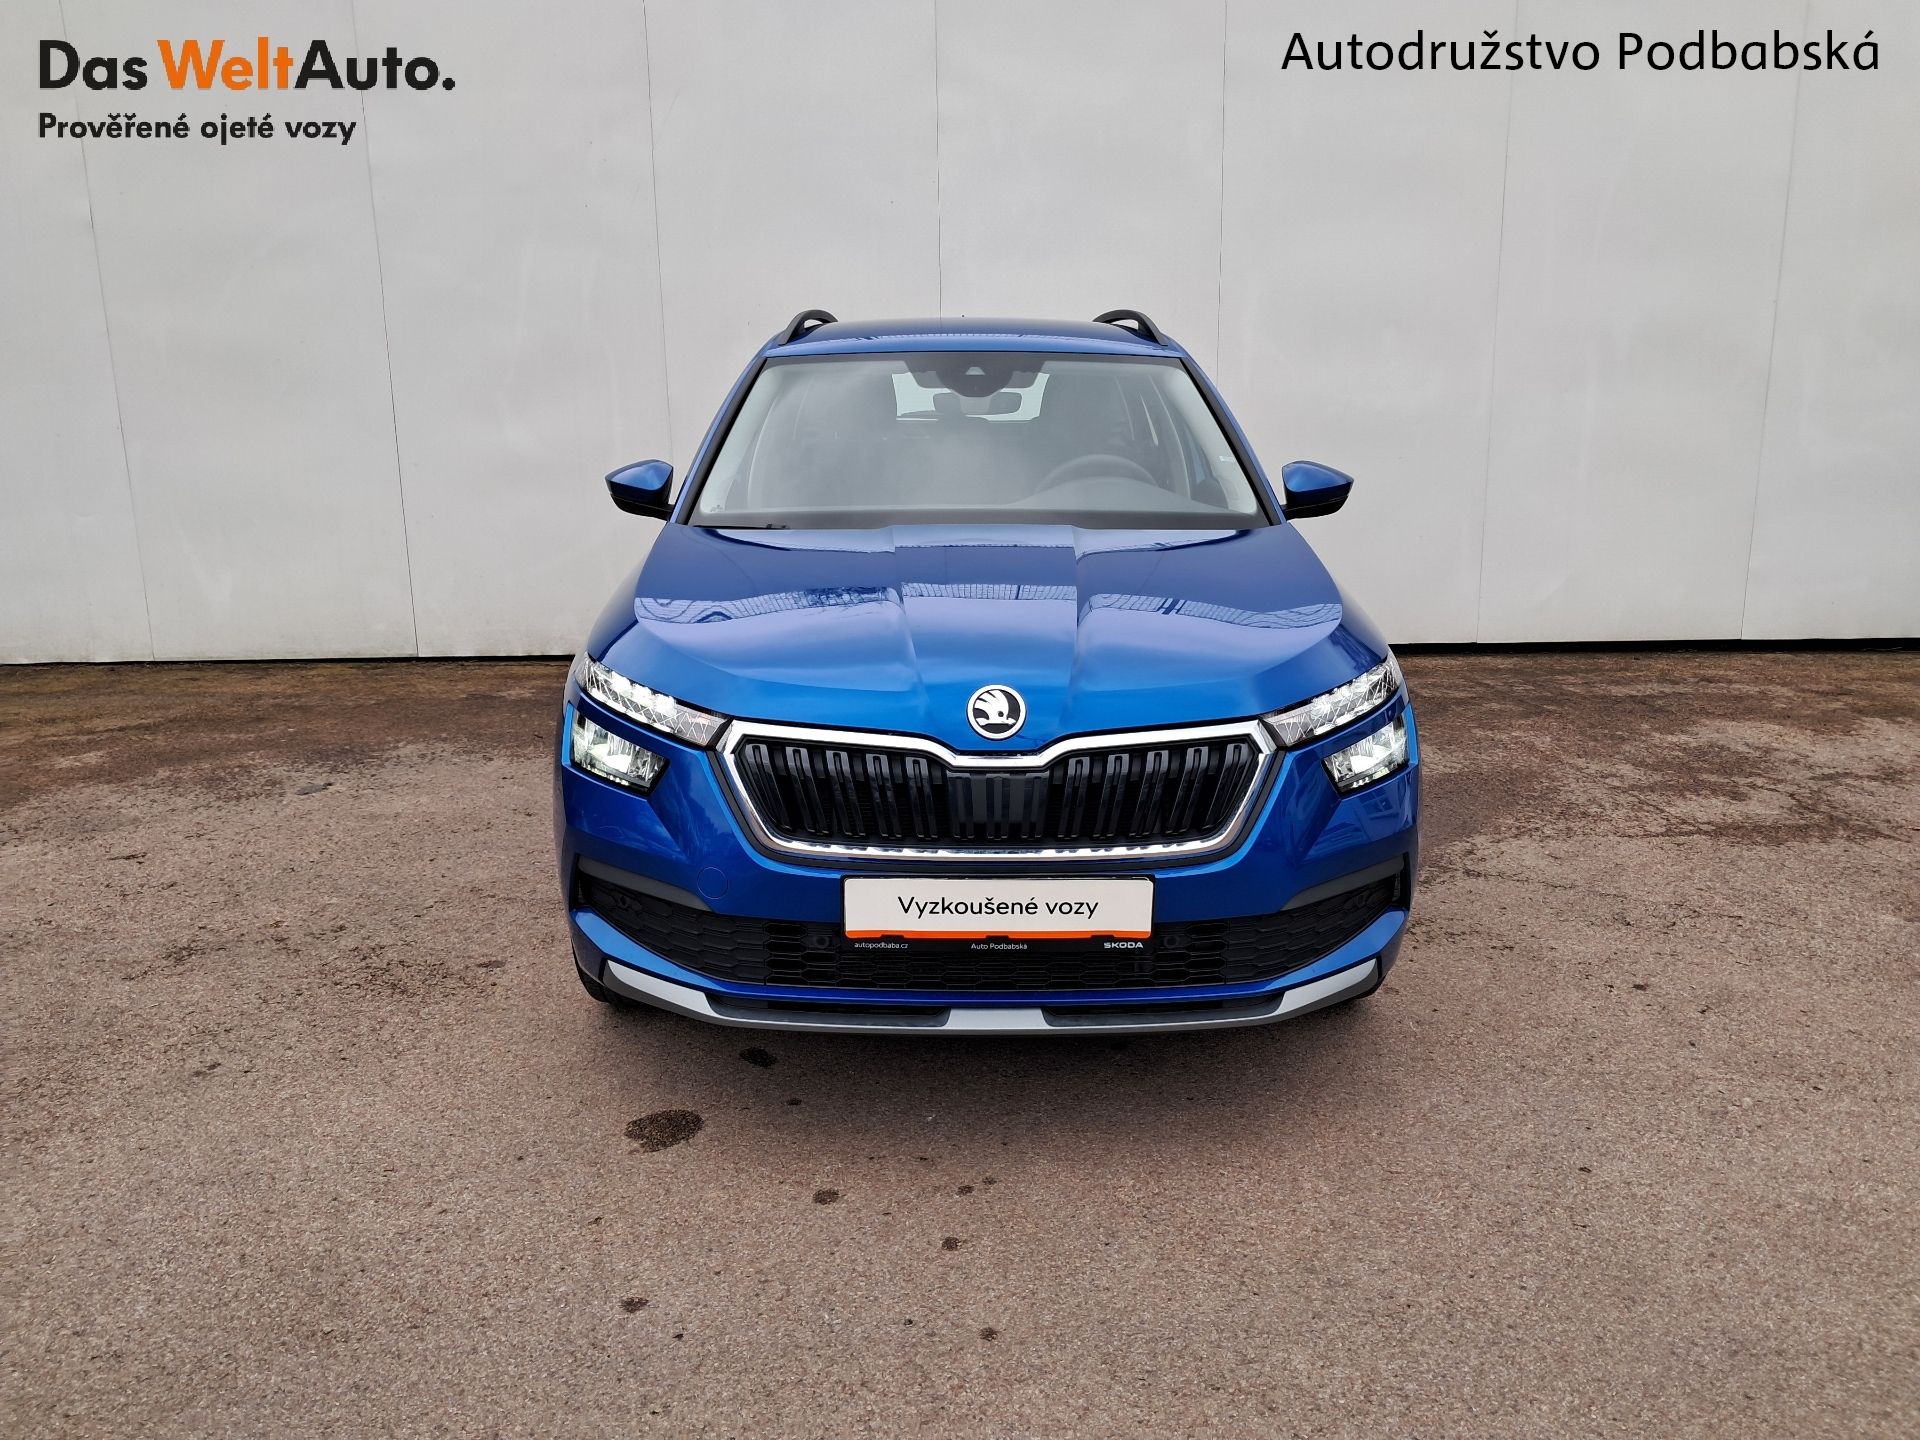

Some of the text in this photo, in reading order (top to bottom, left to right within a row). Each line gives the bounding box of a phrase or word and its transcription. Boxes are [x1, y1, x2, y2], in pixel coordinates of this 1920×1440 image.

[897, 896, 1099, 919] Vyzkoušené vozy
[854, 941, 909, 950] autopodbaba.cz
[970, 942, 988, 950] Auto
